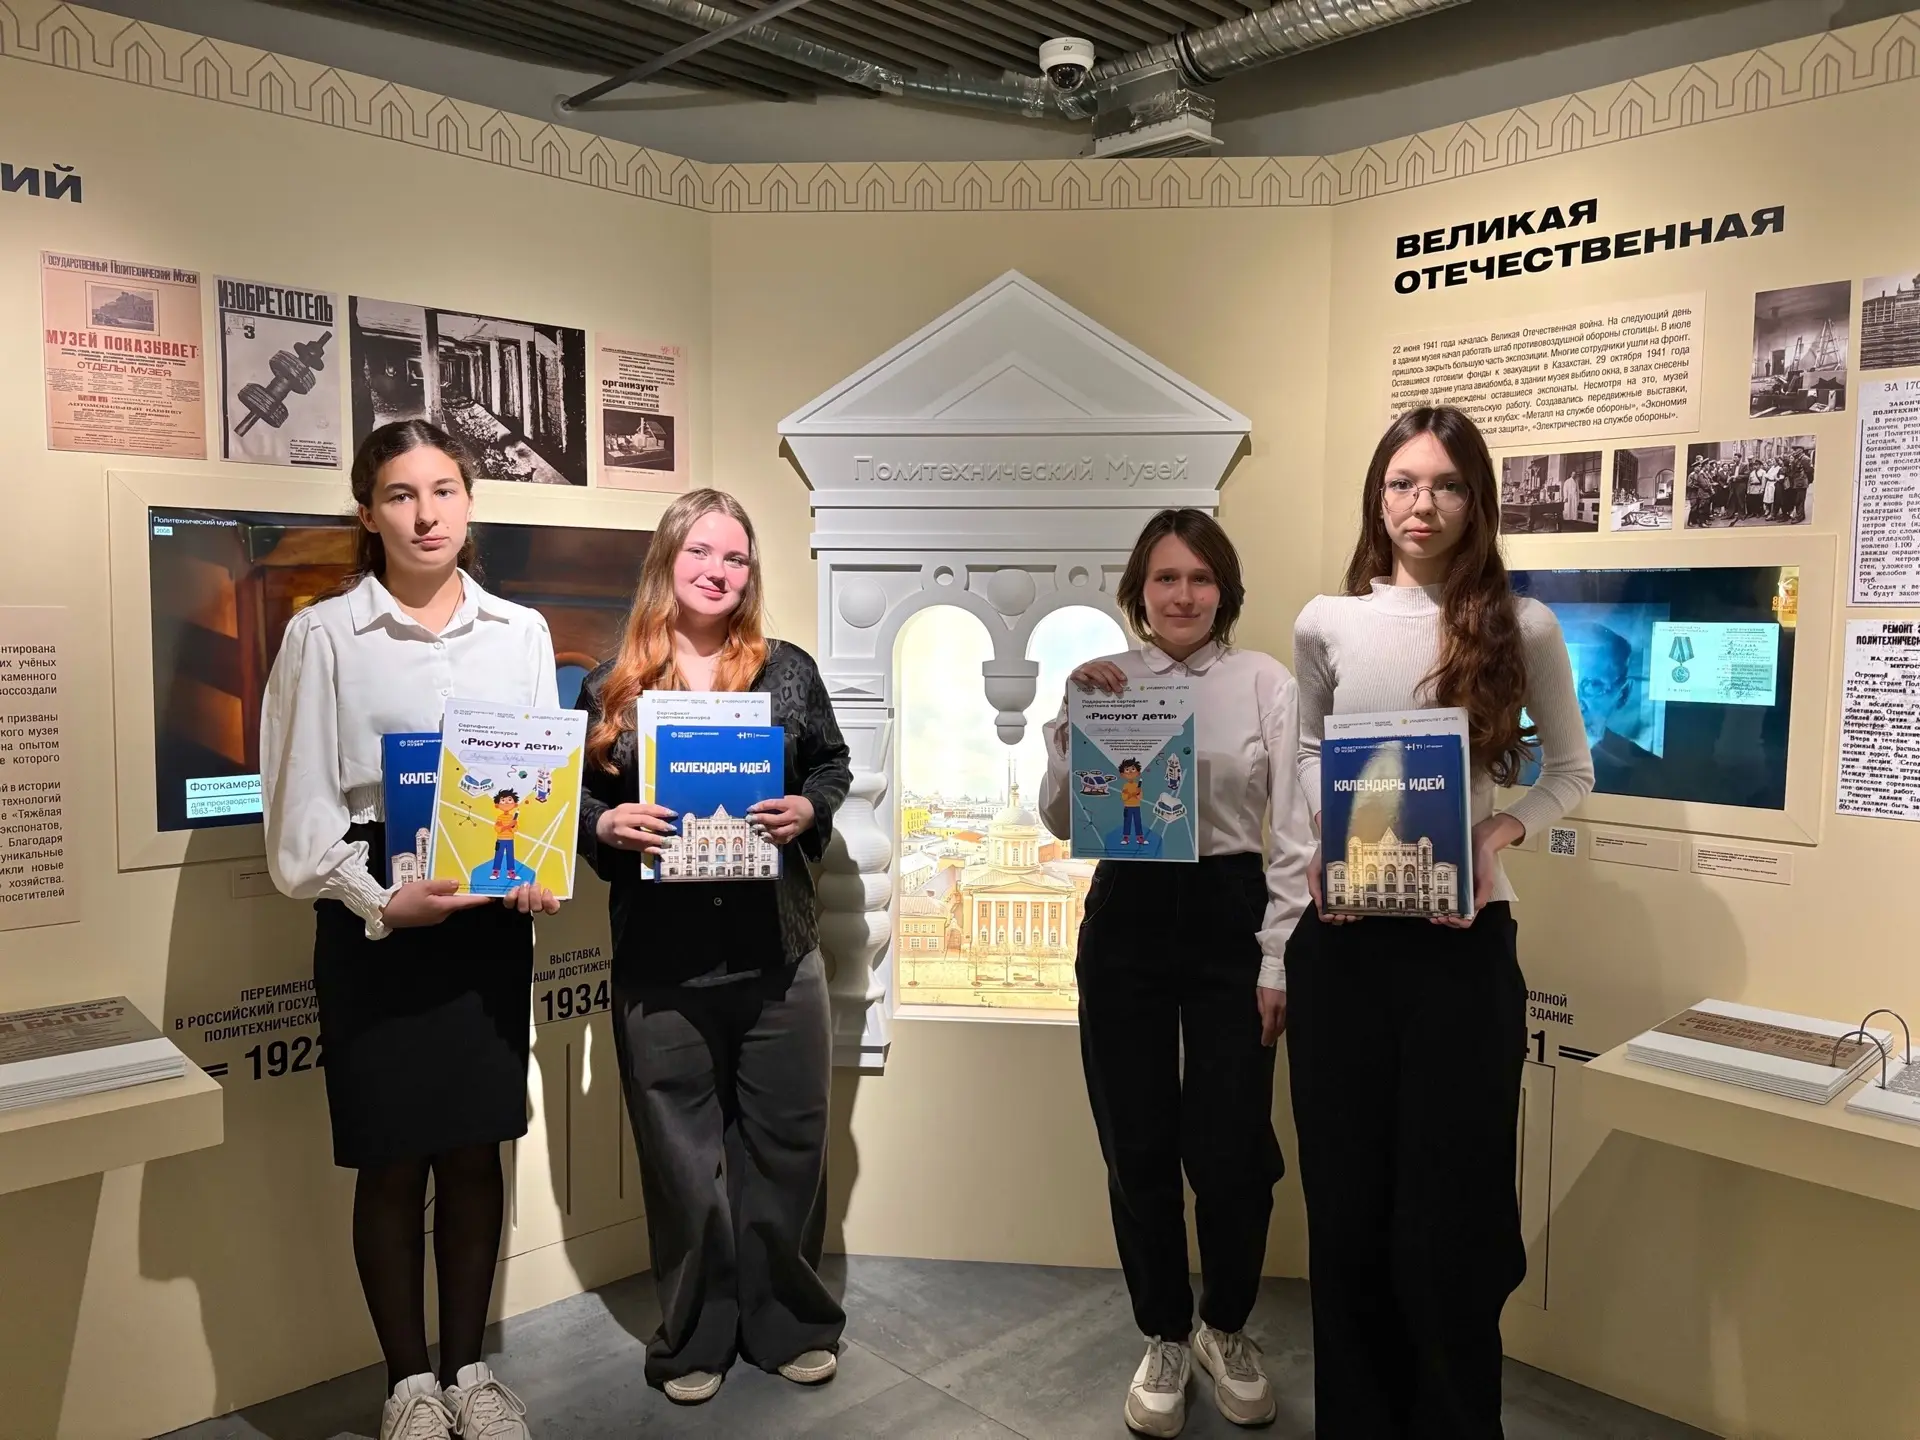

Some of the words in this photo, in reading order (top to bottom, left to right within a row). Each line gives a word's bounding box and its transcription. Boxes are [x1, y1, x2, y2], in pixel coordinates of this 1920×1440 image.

[1395, 198, 1598, 260] ВЕЛИКАЯ
[1394, 205, 1785, 294] ОТЕЧЕСТВЕННАЯ
[217, 279, 333, 323] ИЗОБРЕТАТЕЛЬ
[45, 328, 98, 349] МУЗЕЙ
[243, 325, 256, 340] 3
[1392, 345, 1402, 355] 22
[1423, 340, 1438, 350] 1941
[1441, 339, 1456, 349] года
[1458, 335, 1489, 346] началась
[1491, 330, 1520, 342] Великая
[1523, 322, 1577, 338] Отечественная
[1579, 320, 1605, 330] война.
[1607, 317, 1618, 326] На
[1621, 309, 1669, 324] следующий
[1671, 307, 1692, 318] день
[1421, 352, 1441, 364] музея
[1442, 350, 1461, 360] начал
[1462, 346, 1492, 359] работать
[1493, 342, 1512, 353] штаб
[1585, 329, 1621, 342] обороны
[1622, 325, 1659, 337] столицы.
[1669, 319, 1692, 330] июле
[1391, 366, 1424, 378] пришлось
[1425, 362, 1452, 374] закрыть
[1452, 357, 1485, 371] большую
[1485, 355, 1504, 365] часть
[1505, 350, 1549, 364] экспозиции.
[1550, 345, 1580, 358] Многие
[1580, 340, 1625, 354] сотрудники
[1626, 337, 1648, 349] ушли
[1650, 337, 1660, 345] на
[1661, 333, 1691, 347] фронт.
[76, 361, 127, 374] ОТДЕЛЫ
[1391, 375, 1430, 388] Оставшиеся
[1433, 372, 1464, 383] готовили
[1466, 368, 1492, 380] фонды
[1503, 363, 1540, 376] эвакуации
[1552, 358, 1592, 370] Казахстан.
[1595, 354, 1607, 364] 29
[1610, 351, 1642, 363] октября
[1646, 347, 1666, 358] 1941
[1670, 345, 1690, 357] года
[602, 379, 659, 393] организуют
[1400, 387, 1429, 399] соседнее
[1429, 384, 1453, 396] здание
[1453, 383, 1473, 394] упала
[1474, 379, 1514, 391] авиабомба,
[1520, 375, 1547, 386] здании
[1547, 371, 1570, 382] музея
[1570, 367, 1601, 379] выбило
[1601, 367, 1622, 377] окна,
[1630, 364, 1653, 373] залах
[1654, 359, 1689, 371] снесены
[1443, 393, 1487, 405] повреждены
[1490, 388, 1533, 400] оставшиеся
[1537, 385, 1579, 396] экспонаты.
[1583, 379, 1622, 391] Несмотря
[1626, 377, 1637, 386] на
[1641, 376, 1658, 385] это,
[1663, 370, 1689, 382] музей
[1884, 382, 1899, 392] ЗА
[1505, 399, 1532, 412] работу.
[1535, 396, 1584, 408] Создавались
[1587, 390, 1643, 403] передвижные
[1646, 385, 1688, 397] выставки,
[1522, 408, 1554, 420] «Металл
[1566, 405, 1595, 418] службе
[1596, 401, 1639, 414] обороны»,
[1641, 396, 1687, 409] «Экономия
[1498, 422, 1531, 434] защита»,
[1532, 416, 1591, 432] «Электричество
[1592, 417, 1602, 426] на
[1603, 412, 1633, 425] службе
[1634, 409, 1679, 422] обороны».
[853, 455, 1094, 482] Политехнический
[1105, 455, 1188, 487] Музей
[153, 516, 216, 526] Политехнический
[216, 519, 238, 528] музей
[1882, 624, 1914, 634] РЕМОНТ
[1, 645, 56, 656] нтирована
[18, 657, 57, 669] учёных
[1, 672, 57, 682] каменного
[7, 714, 58, 725] призваны
[1085, 712, 1138, 721] «Рисуют
[1142, 713, 1177, 721] дети»
[1, 728, 24, 738] кого
[28, 726, 59, 738] музея
[19, 740, 60, 751] опытом
[460, 737, 520, 750] «Рисуют
[524, 741, 563, 752] дети»
[13, 754, 60, 765] которого
[670, 761, 737, 775] КАЛЕНДАРЬ
[739, 759, 771, 775] ИДЕЙ
[18, 781, 61, 792] истории
[190, 779, 261, 792] Фотокамера
[1333, 778, 1406, 793] КАЛЕНДАРЬ
[1409, 775, 1445, 791] ИДЕЙ
[2, 793, 61, 807] технологий
[191, 801, 205, 809] для
[206, 796, 260, 808] производства
[12, 807, 62, 819] «Тяжёлая
[0, 821, 63, 835] экспонатов,
[8, 835, 63, 848] Благодаря
[0, 848, 64, 863] уникальные
[31, 861, 64, 873] новые
[9, 874, 65, 889] хозяйства.
[0, 887, 65, 903] посетителей
[549, 946, 601, 966] ВЫСТАВКА
[558, 959, 611, 980] ДОСТИЖЕН
[540, 980, 610, 1021] 1934
[1527, 990, 1568, 1008] ОЛНОЙ
[175, 1018, 184, 1030] В
[188, 999, 275, 1029] РОССИЙСКИЙ
[1529, 1006, 1574, 1025] ЗДАНИЕ
